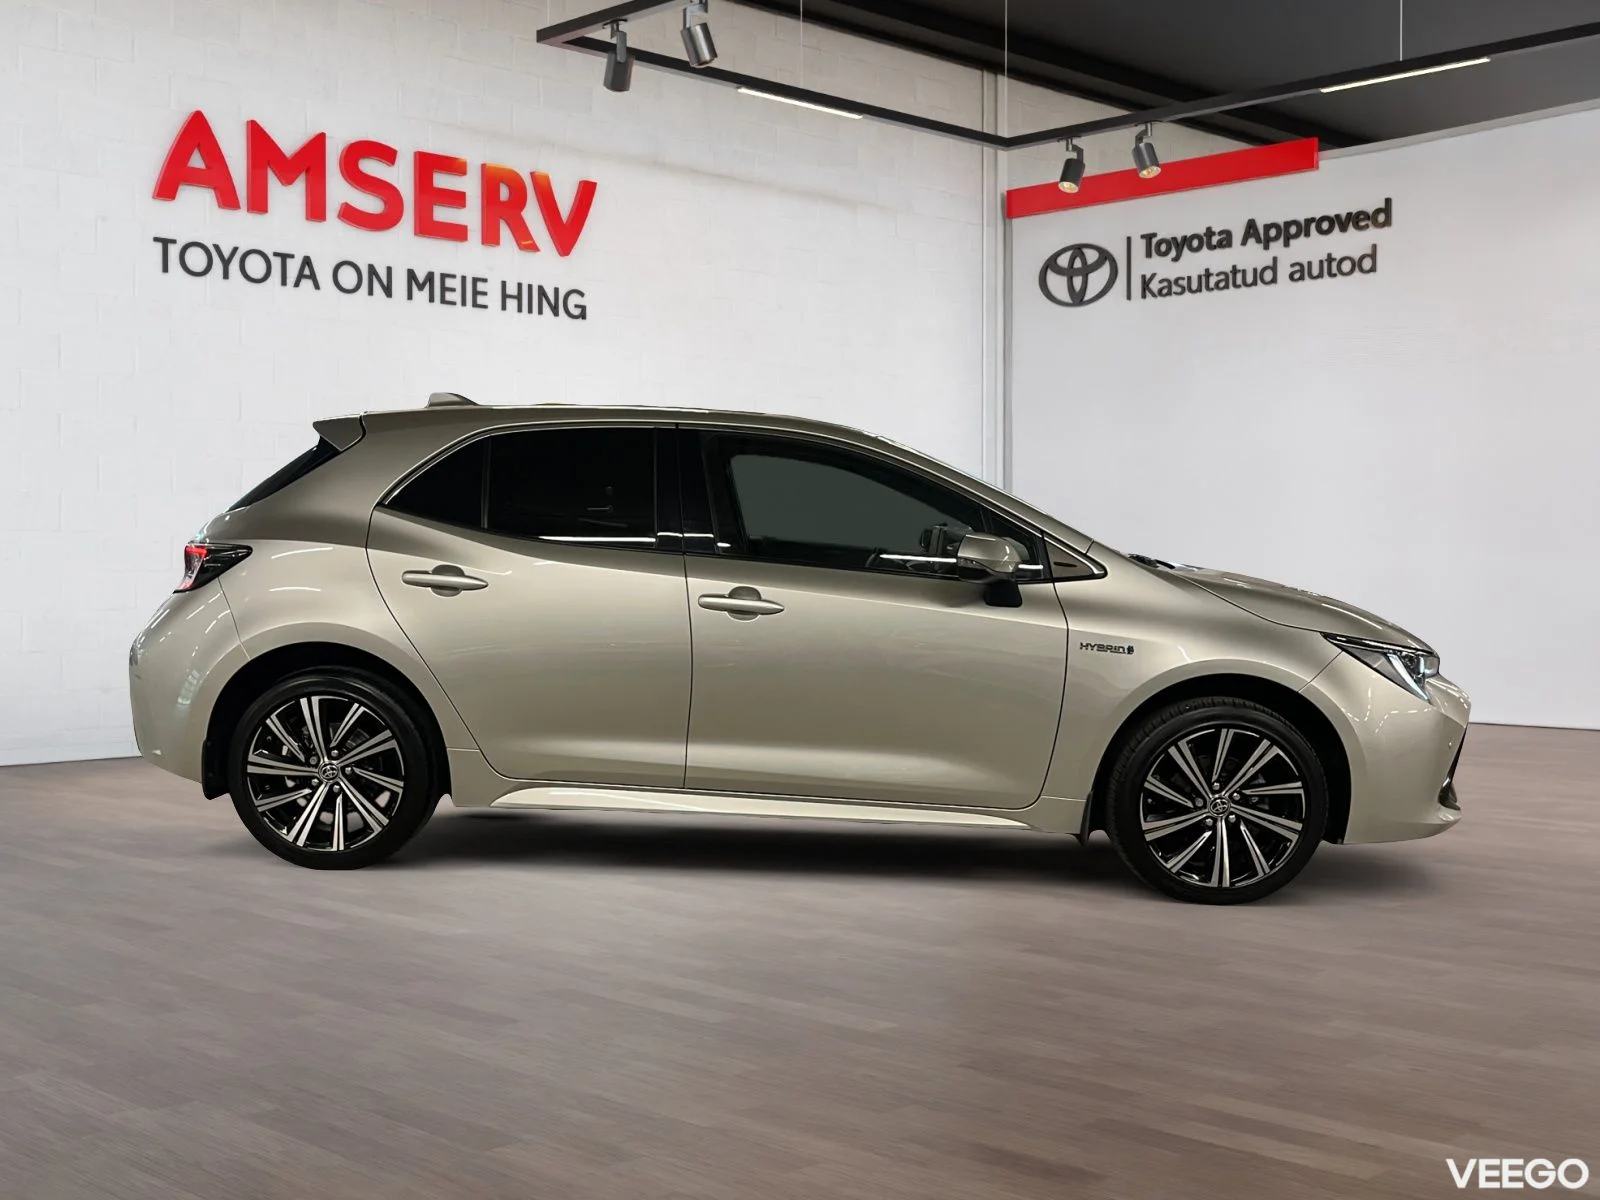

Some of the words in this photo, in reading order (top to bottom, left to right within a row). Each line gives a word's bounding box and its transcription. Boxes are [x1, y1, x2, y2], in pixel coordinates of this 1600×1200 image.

[152, 109, 598, 258] AMSERV
[1140, 226, 1233, 262] Toyota
[1241, 197, 1393, 251] Approved
[153, 236, 321, 291] TOYOTA
[332, 259, 393, 299] ON
[406, 267, 489, 310] MEIE
[500, 279, 588, 321] HING
[1140, 256, 1278, 300] Kasutatud
[1288, 243, 1378, 282] autod
